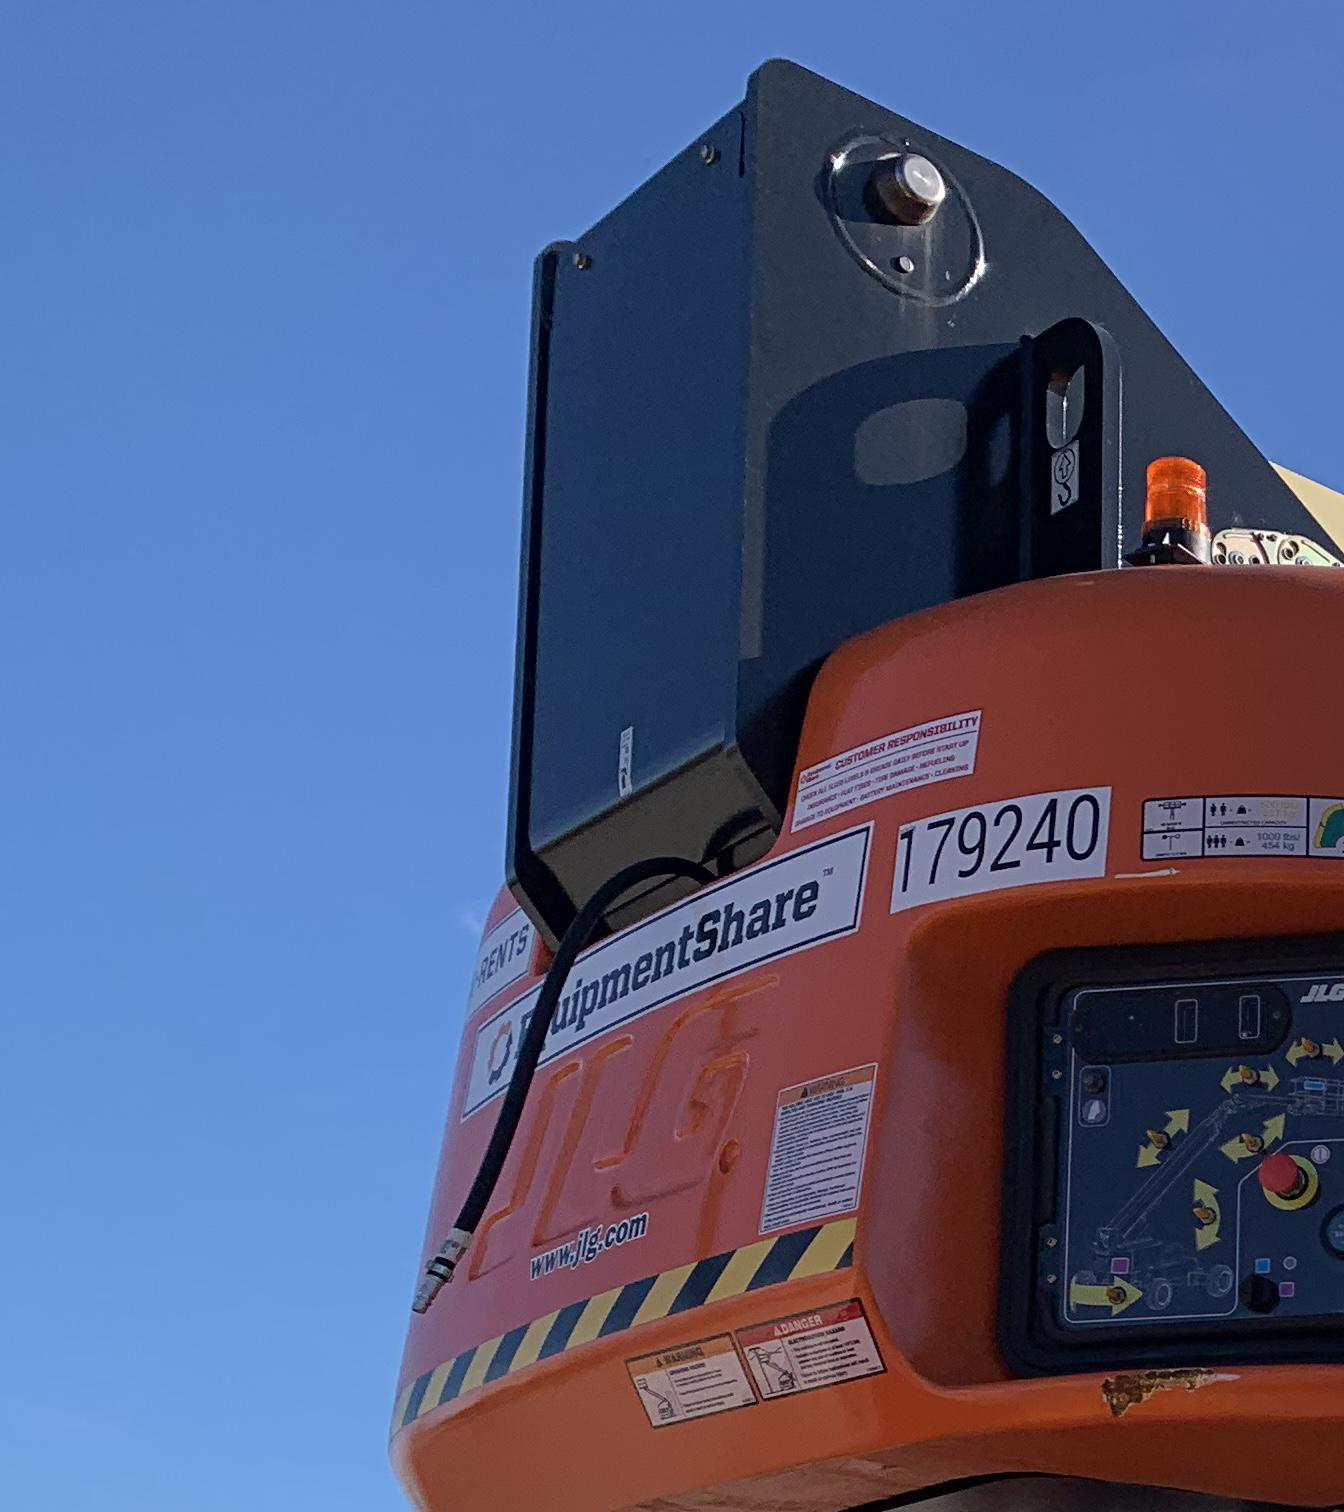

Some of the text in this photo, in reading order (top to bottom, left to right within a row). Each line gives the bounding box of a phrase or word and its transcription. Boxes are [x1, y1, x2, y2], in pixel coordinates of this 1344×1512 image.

[834, 716, 979, 771] CUSTOMER RESPONSIBILITY
[919, 754, 956, 770] REFUELING
[934, 763, 969, 778] CLEANING
[899, 793, 1101, 893] 179240
[514, 877, 821, 1060] uipmentShare
[530, 1213, 648, 1280] www.jlg.com
[781, 1314, 824, 1336] DANGER
